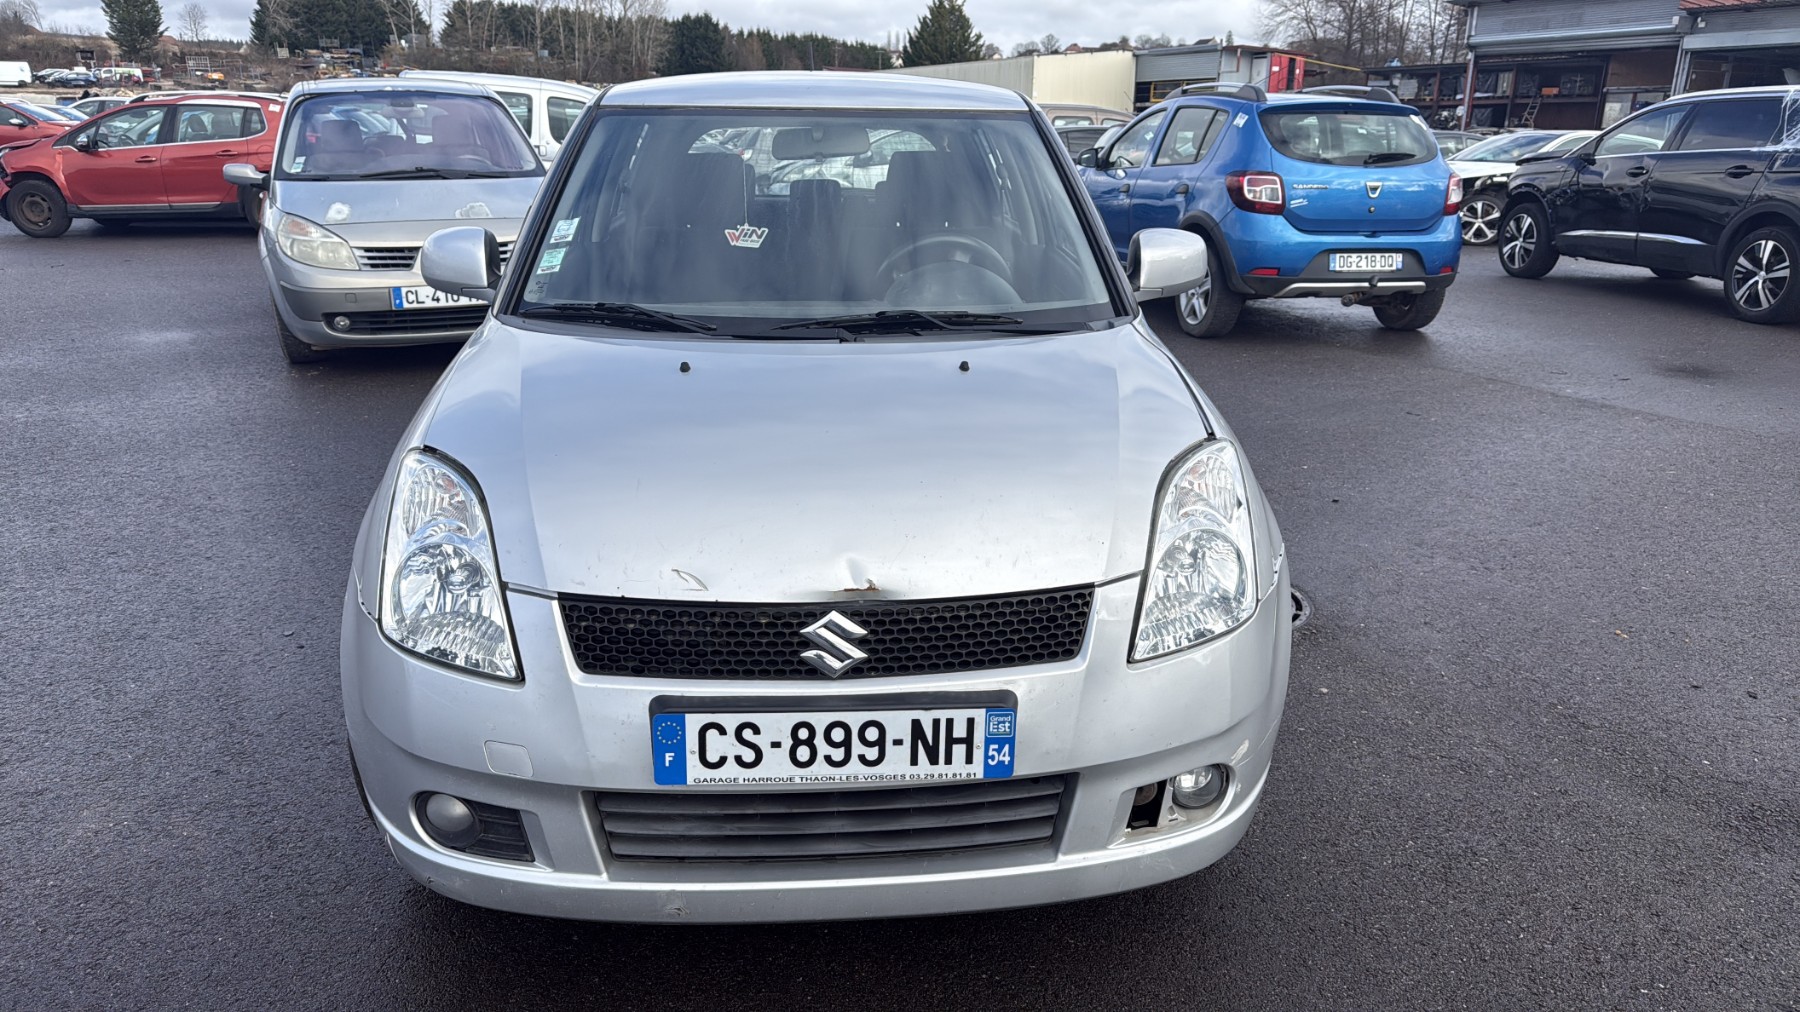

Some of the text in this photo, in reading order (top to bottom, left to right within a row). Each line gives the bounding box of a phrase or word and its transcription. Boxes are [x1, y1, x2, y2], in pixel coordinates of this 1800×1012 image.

[1338, 255, 1394, 268] DG-218-DQ
[405, 288, 482, 305] CL-41
[990, 722, 1010, 732] Est
[699, 717, 975, 769] CS-899-NH
[665, 752, 675, 767] F
[988, 744, 1010, 765] 54
[799, 774, 906, 782] THAON-LES-VOSGES
